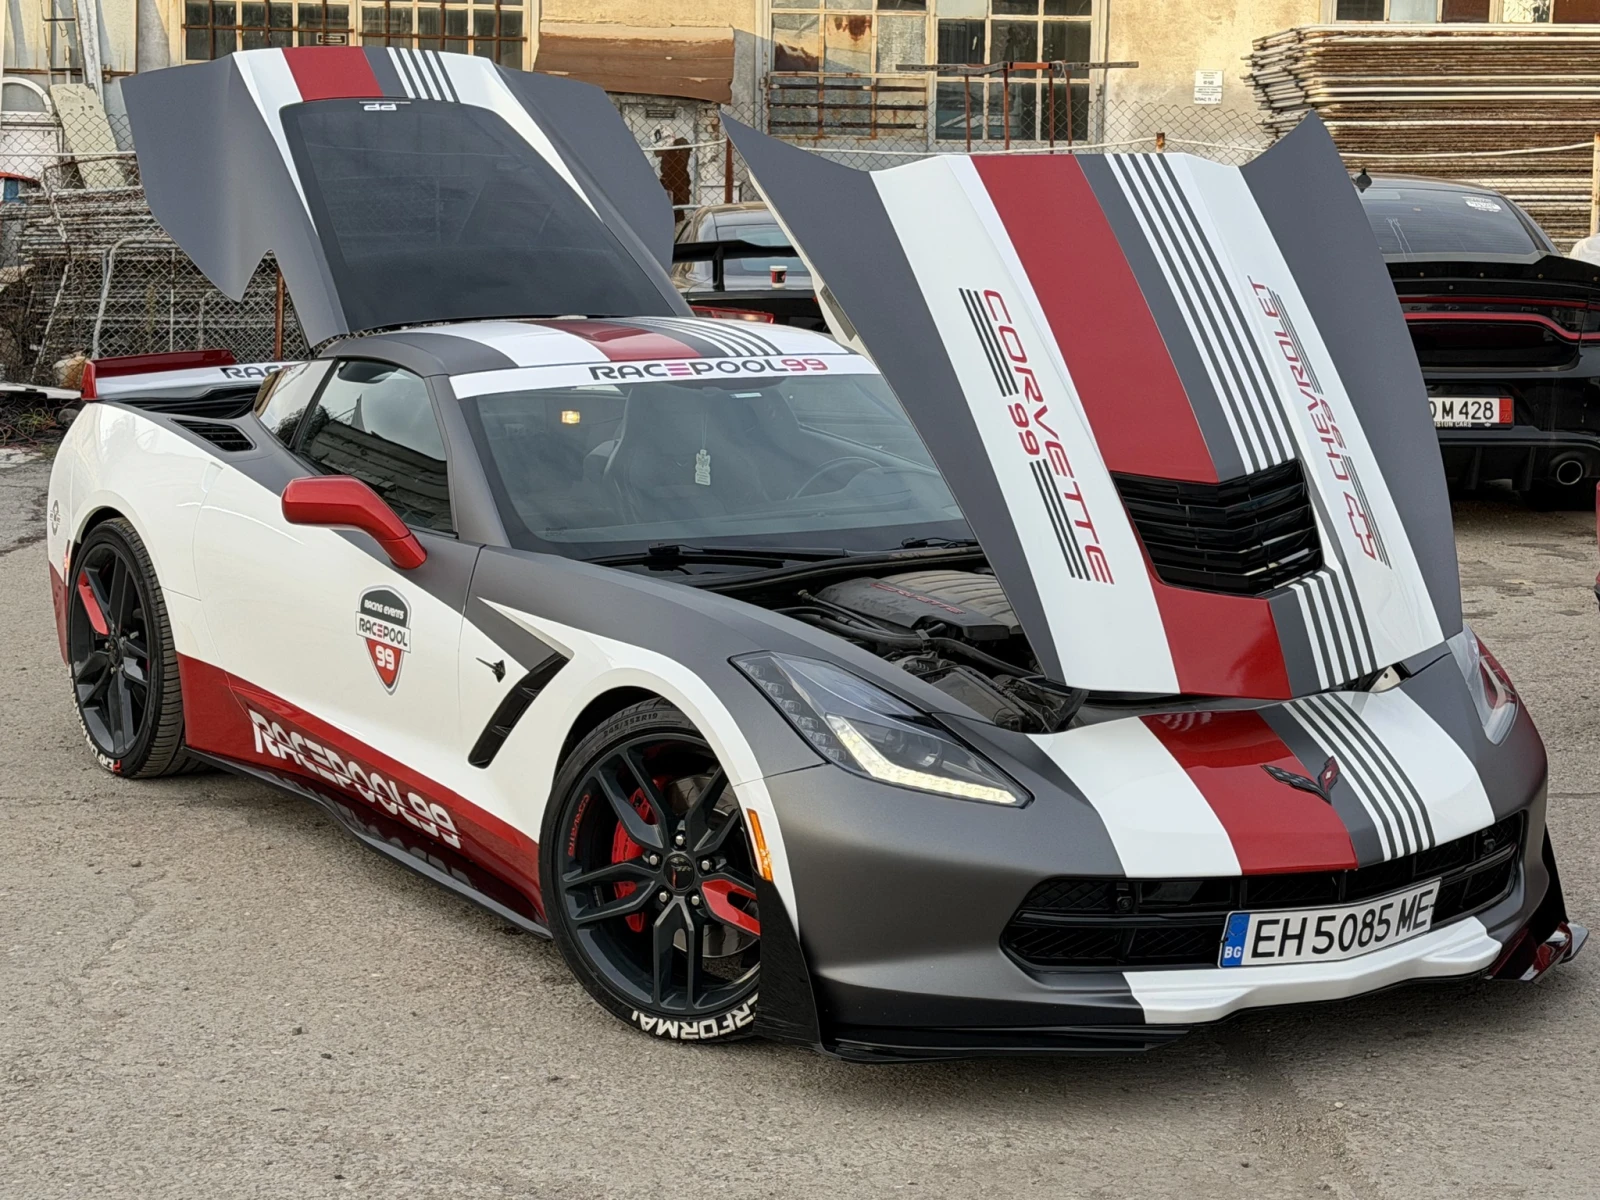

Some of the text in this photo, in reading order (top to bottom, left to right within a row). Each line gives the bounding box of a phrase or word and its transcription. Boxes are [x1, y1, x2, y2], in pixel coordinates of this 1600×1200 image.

[588, 358, 828, 381] RACEPOOL99
[1248, 275, 1350, 481] CHEVROLET
[983, 289, 1115, 585] CORVETTE
[1007, 402, 1041, 456] 99
[1459, 401, 1494, 420] 428
[359, 617, 408, 647] RACEPOOL
[375, 645, 395, 671] 99
[248, 708, 461, 849] RACEPOOL99
[1224, 888, 1434, 958] BG EH 5085 ME
